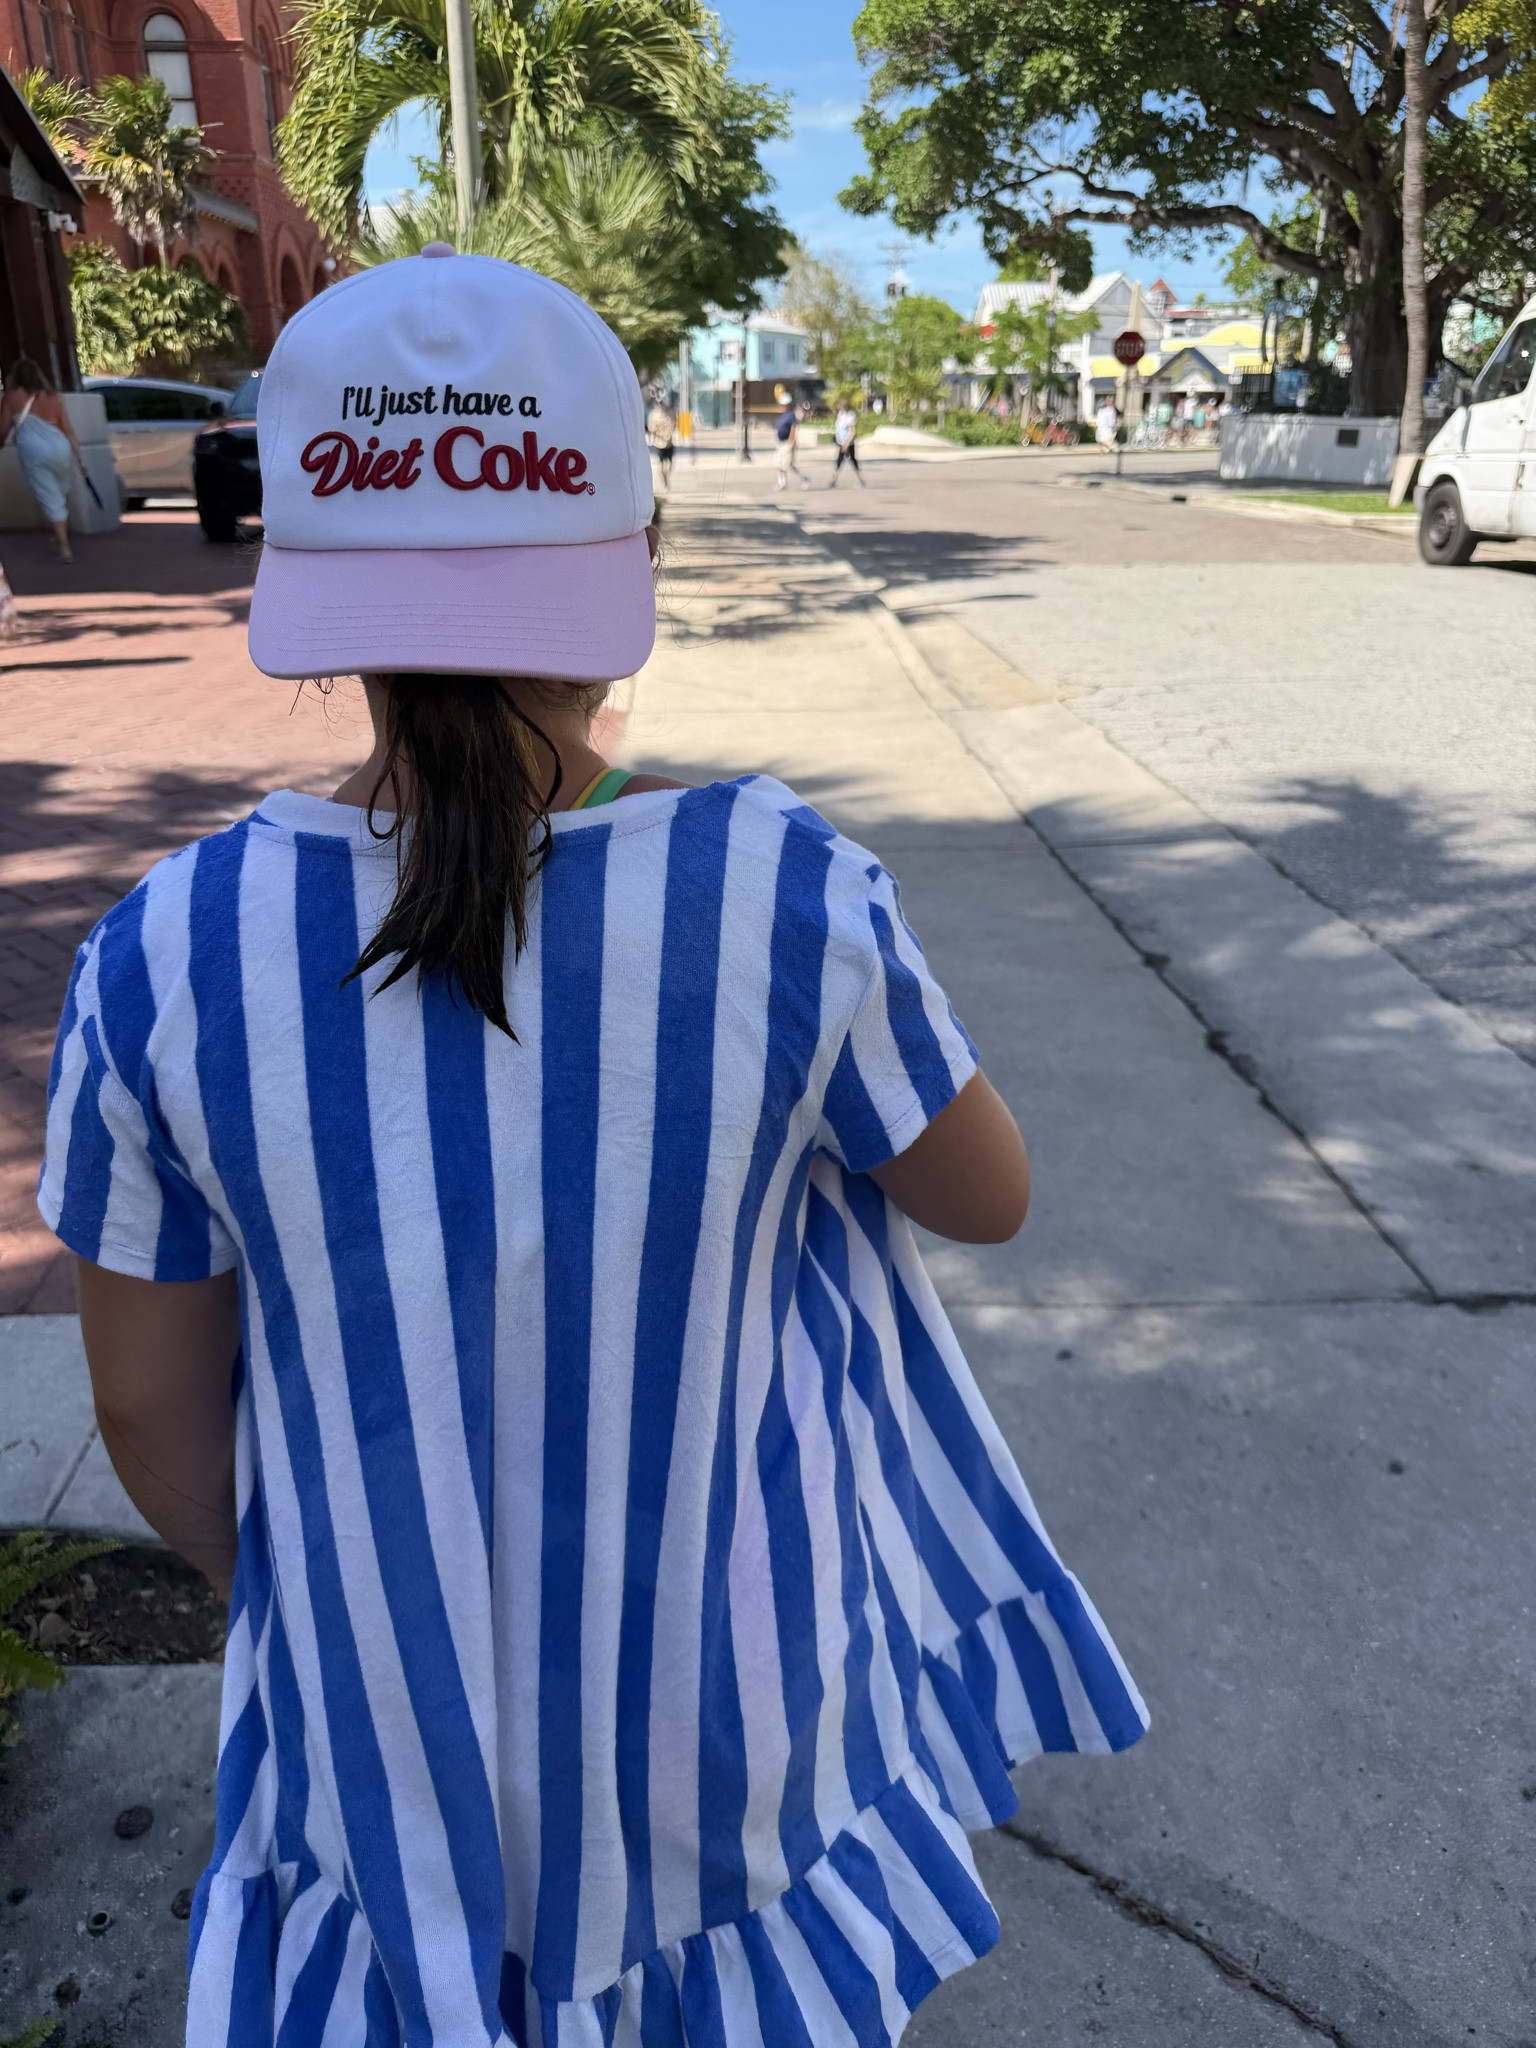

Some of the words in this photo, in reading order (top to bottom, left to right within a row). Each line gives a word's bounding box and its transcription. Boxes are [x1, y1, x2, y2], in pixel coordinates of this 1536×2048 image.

[1116, 341, 1144, 357] STOP
[342, 385, 375, 420] I'll
[372, 384, 438, 426] just
[442, 384, 514, 418] have
[518, 396, 542, 419] a
[300, 431, 424, 497] Diet
[433, 425, 588, 495] Coke
